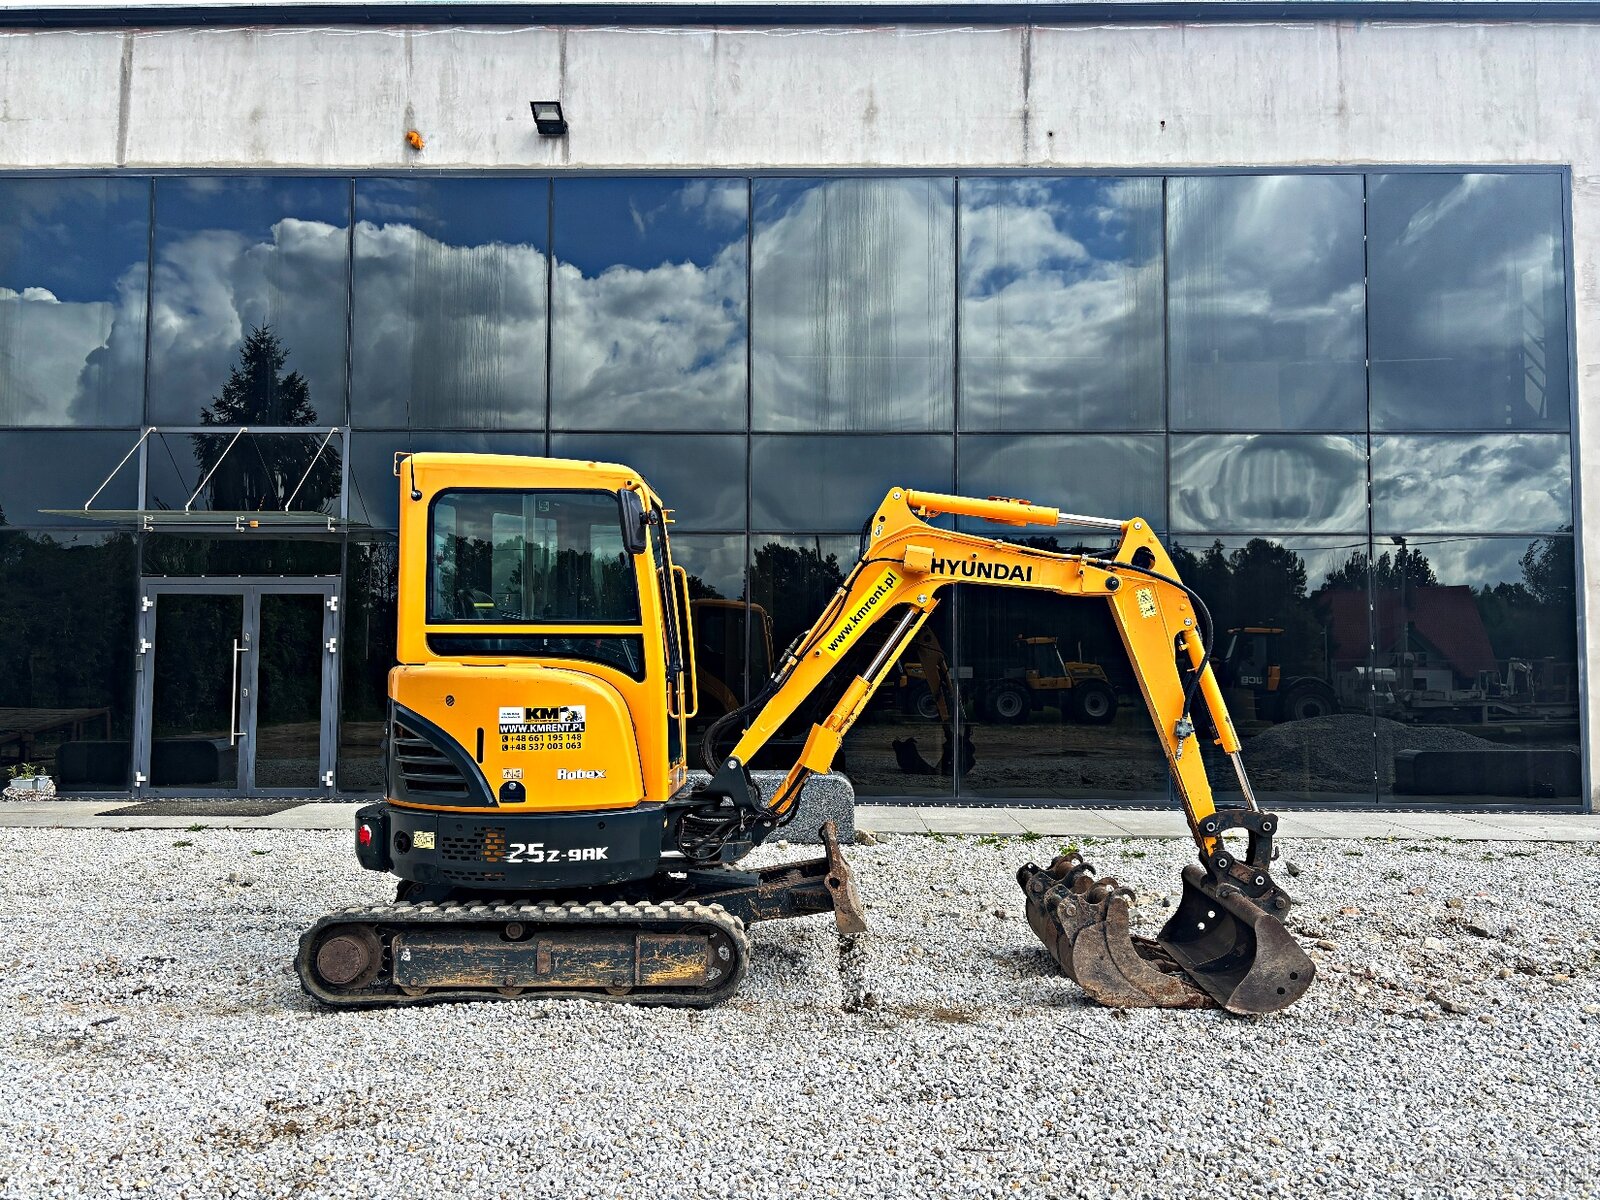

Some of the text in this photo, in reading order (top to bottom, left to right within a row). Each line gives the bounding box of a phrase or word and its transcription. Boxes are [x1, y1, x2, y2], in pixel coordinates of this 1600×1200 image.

[930, 557, 1033, 582] HYUNDAI
[827, 571, 897, 652] www.kmrent.pl
[525, 707, 559, 720] KM
[500, 723, 585, 733] WWW.KMRENT.PL
[509, 734, 526, 742] +48
[528, 734, 544, 742] 661
[566, 733, 582, 741] 148
[509, 741, 582, 751] +48 537 003 063
[557, 768, 607, 780] Robex
